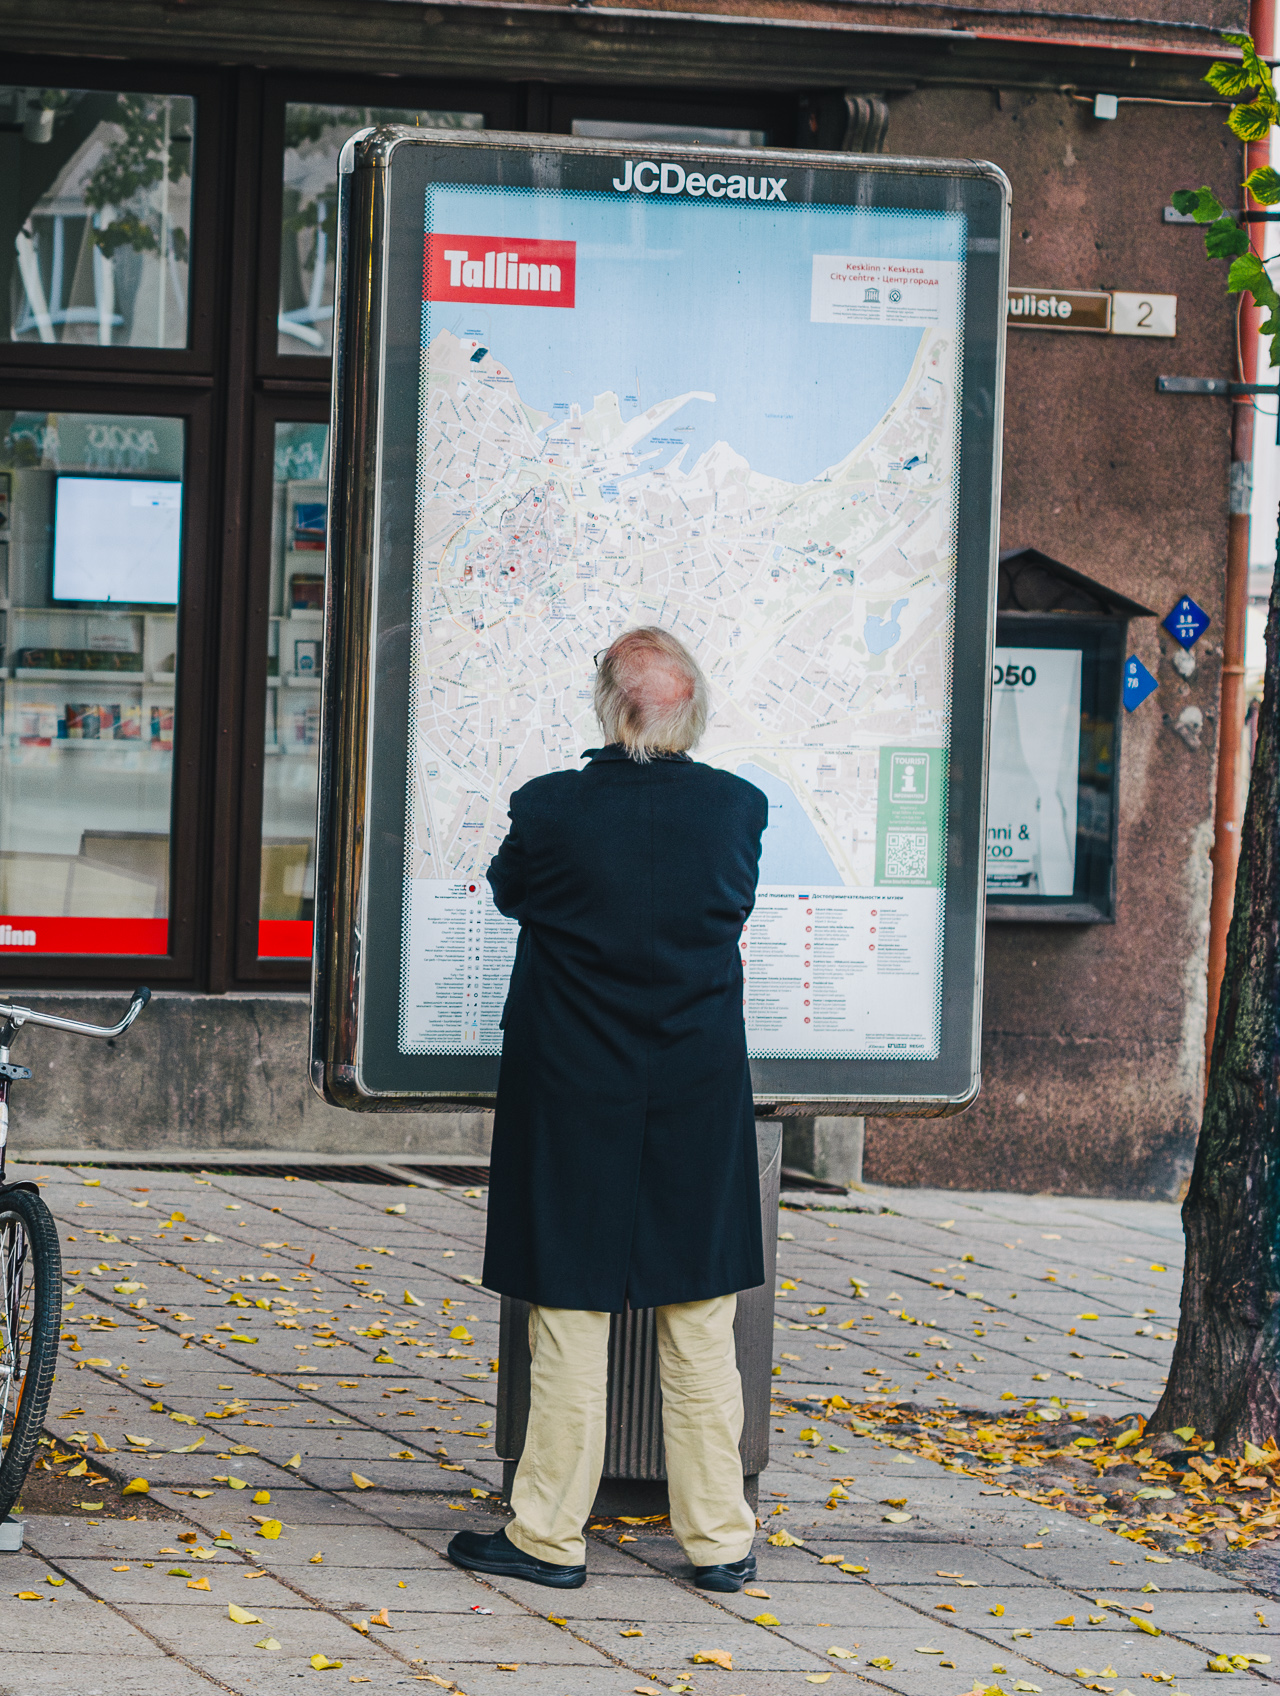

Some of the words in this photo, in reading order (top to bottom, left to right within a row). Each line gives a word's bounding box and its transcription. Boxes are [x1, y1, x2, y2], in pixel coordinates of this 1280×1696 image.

[612, 160, 788, 202] JCDecaux
[444, 250, 561, 292] Tallinn
[846, 263, 880, 272] Kesklinn
[888, 265, 924, 274] Keskusta
[830, 273, 847, 282] City
[848, 274, 875, 282] centre
[882, 275, 908, 285] Центр
[909, 278, 939, 286] города
[1137, 302, 1153, 328] 2
[894, 757, 926, 765] TOURIST
[1018, 824, 1030, 840] &
